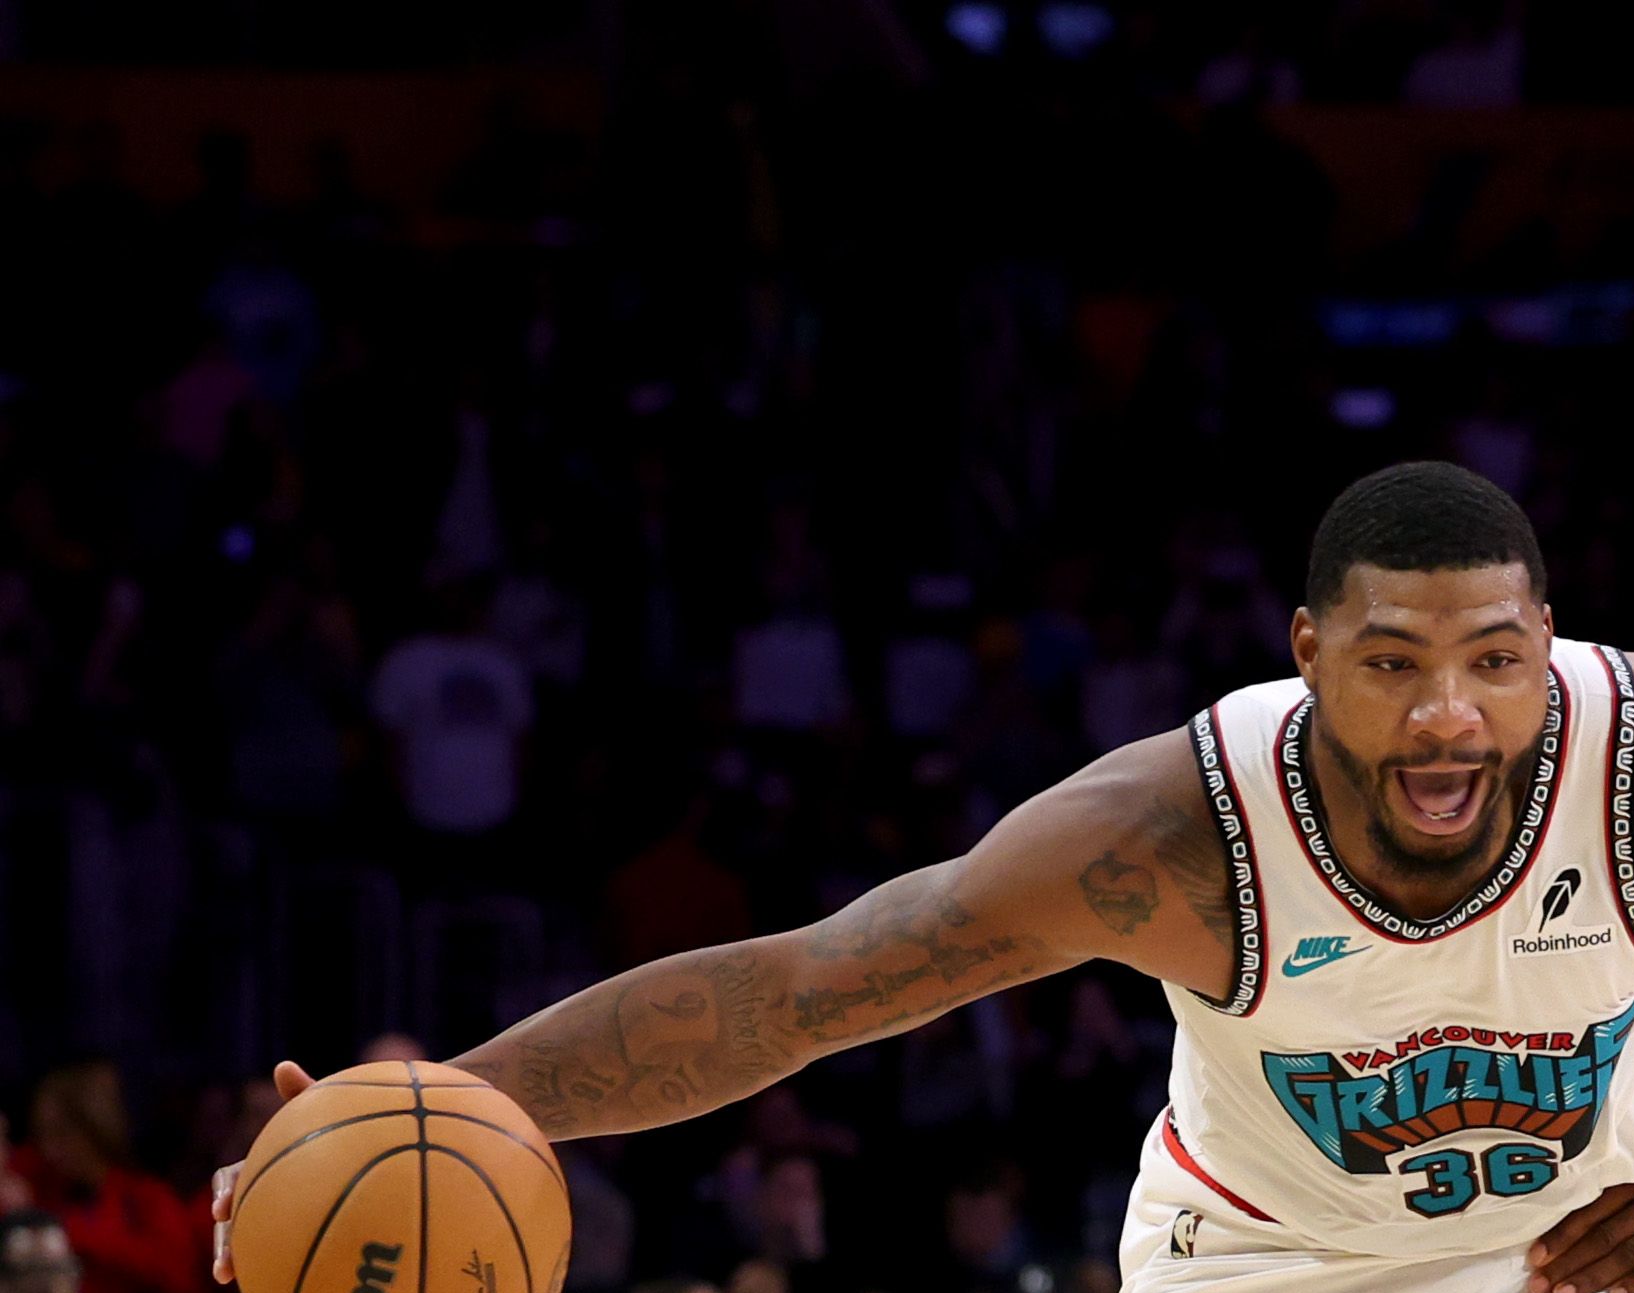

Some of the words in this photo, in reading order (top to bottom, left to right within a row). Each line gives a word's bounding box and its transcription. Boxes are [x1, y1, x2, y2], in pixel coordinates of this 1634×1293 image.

[1293, 936, 1351, 960] NIKE
[1513, 927, 1611, 954] Robinhood
[1342, 1025, 1577, 1072] VANCOUVER
[1398, 1142, 1559, 1219] 36
